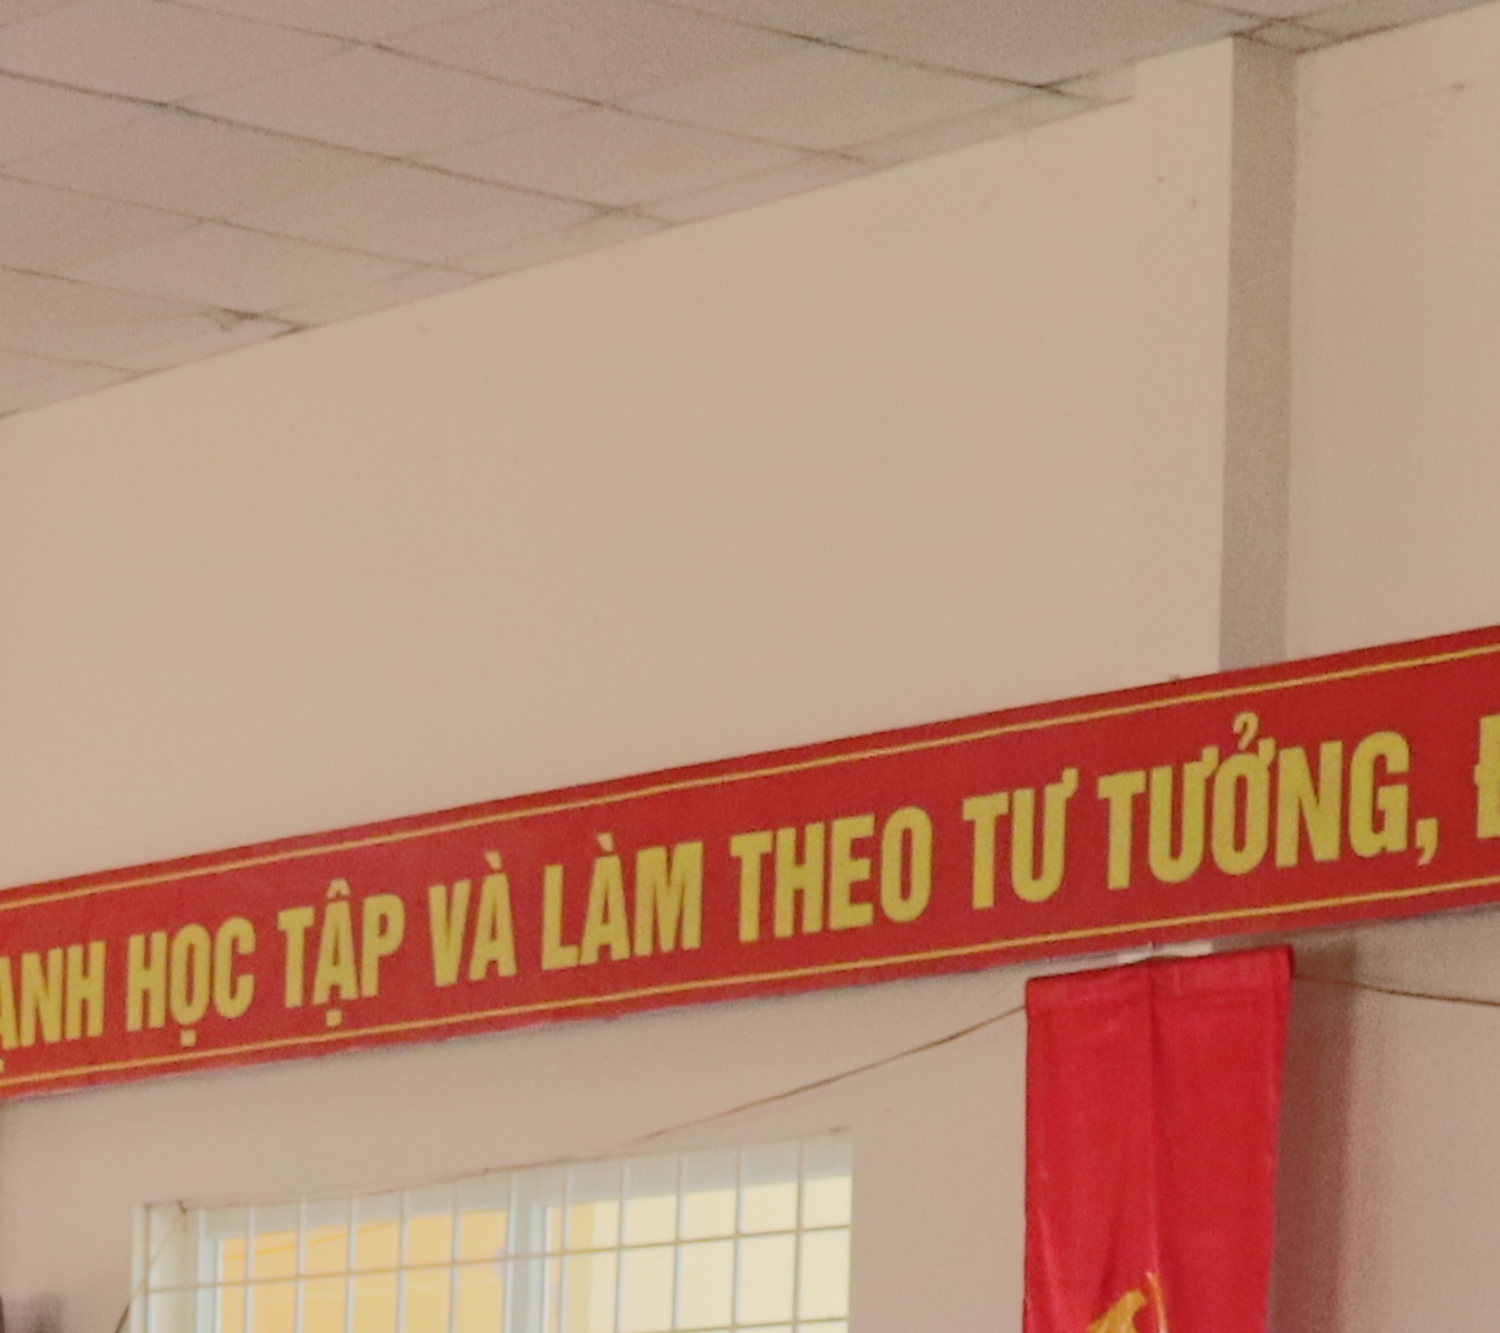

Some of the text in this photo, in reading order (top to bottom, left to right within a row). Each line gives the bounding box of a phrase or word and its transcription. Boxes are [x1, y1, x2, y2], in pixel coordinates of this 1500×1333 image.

[126, 916, 256, 1046] HỌC
[278, 879, 406, 1027] TẬP
[429, 850, 516, 988] VÀ
[541, 833, 703, 971] LÀM
[731, 806, 932, 943] THEO
[962, 767, 1078, 910] TƯ
[1097, 713, 1438, 890] TƯỞNG,
